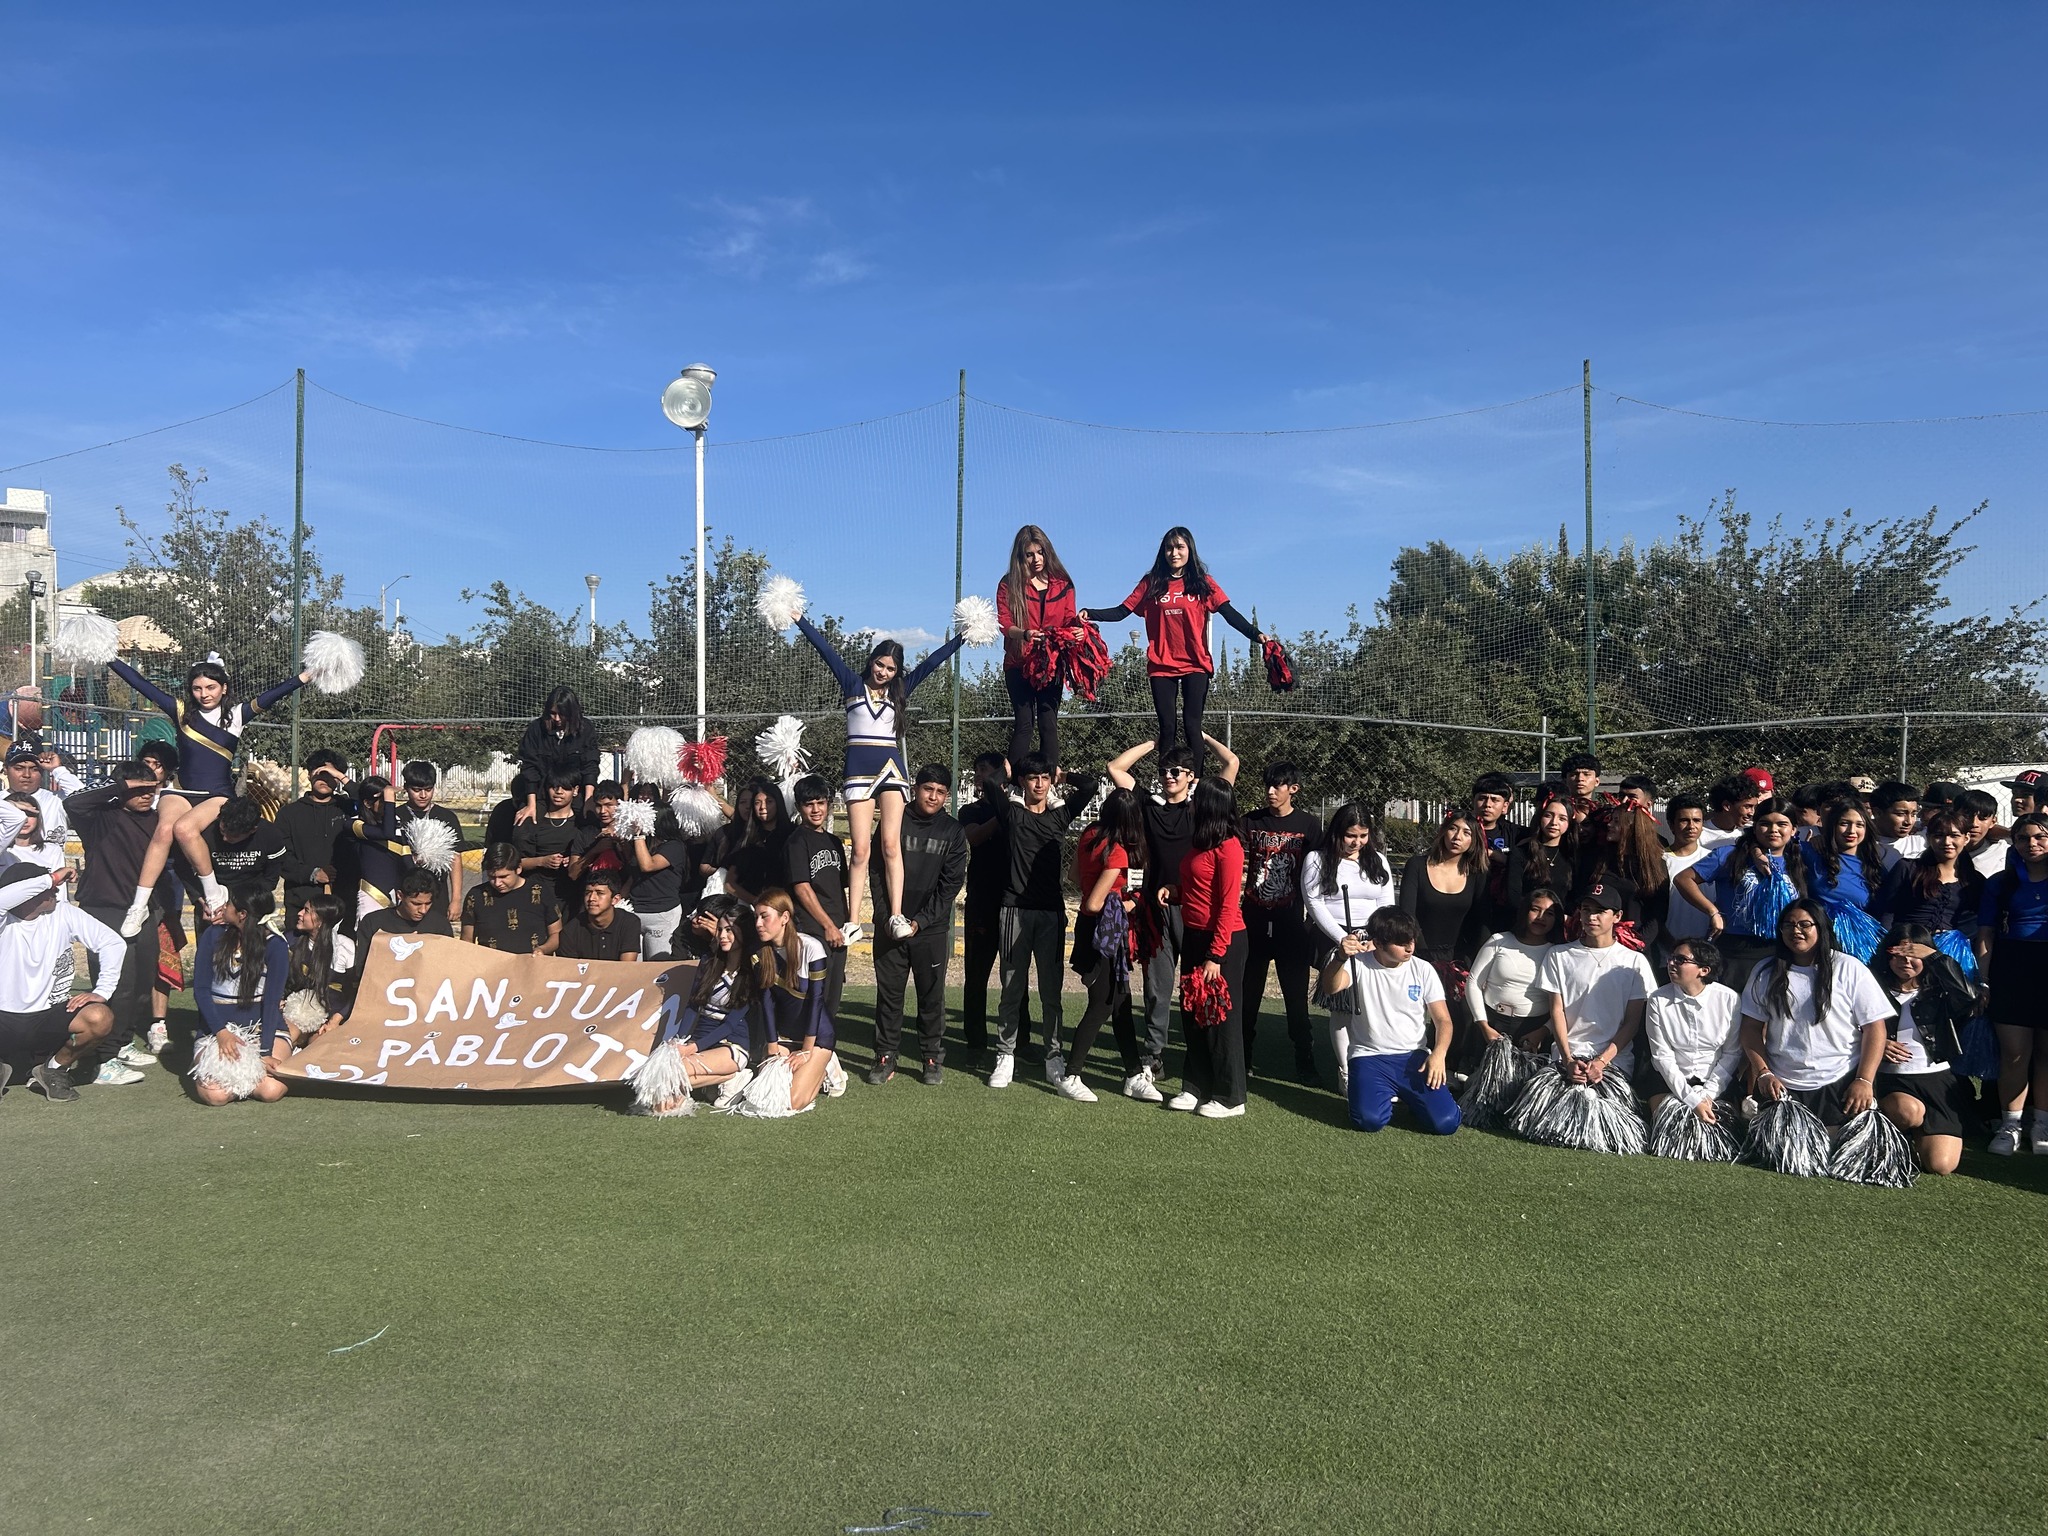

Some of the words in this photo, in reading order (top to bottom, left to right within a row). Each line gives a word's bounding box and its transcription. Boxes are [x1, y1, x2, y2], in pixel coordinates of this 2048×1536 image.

[1592, 884, 1604, 895] B
[384, 978, 509, 1027] SAN
[532, 981, 681, 1043] JUAN
[377, 1033, 568, 1069] PABLO
